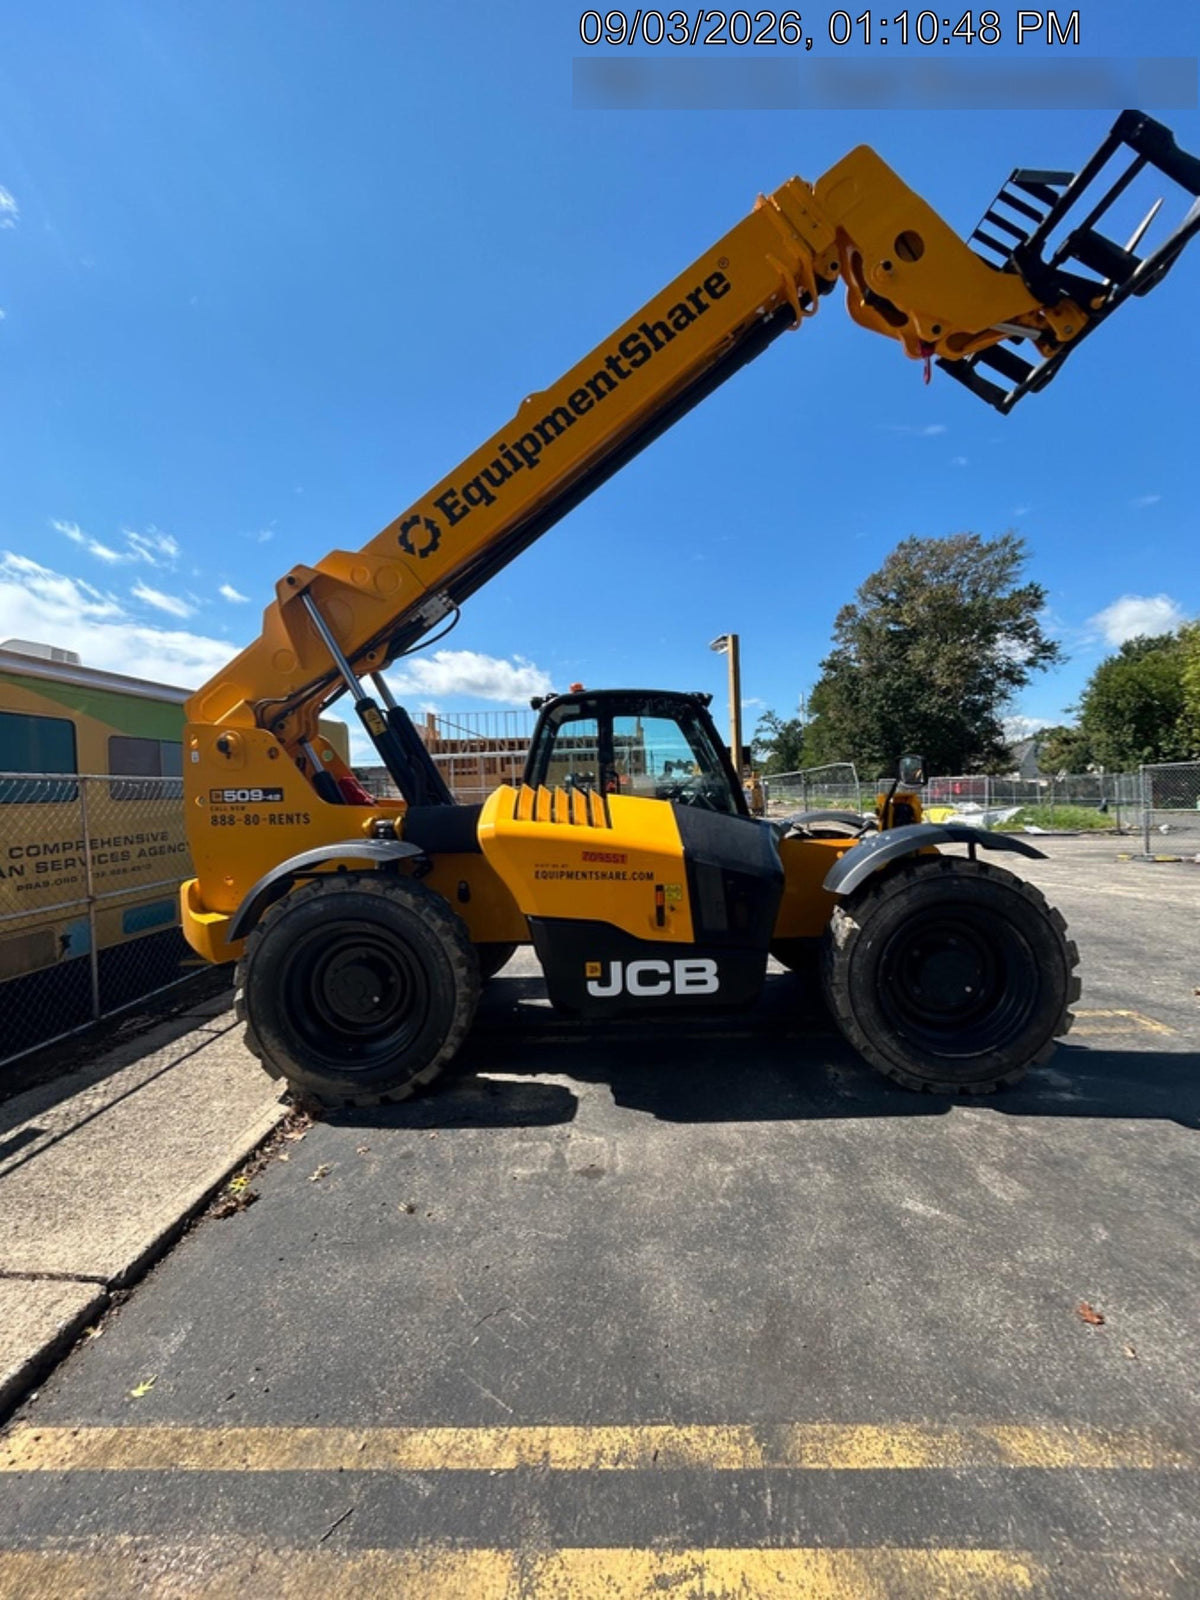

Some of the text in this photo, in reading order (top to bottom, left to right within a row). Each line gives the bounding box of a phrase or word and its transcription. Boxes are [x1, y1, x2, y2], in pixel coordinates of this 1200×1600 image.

[433, 270, 732, 527] EquipmentShare
[9, 831, 169, 859] COMPREHENSIVE
[35, 850, 131, 875] SERVICES
[137, 842, 190, 859] AGENC
[534, 869, 655, 882] EQUIPMENTSHARE.COM
[586, 957, 720, 997] JCB
